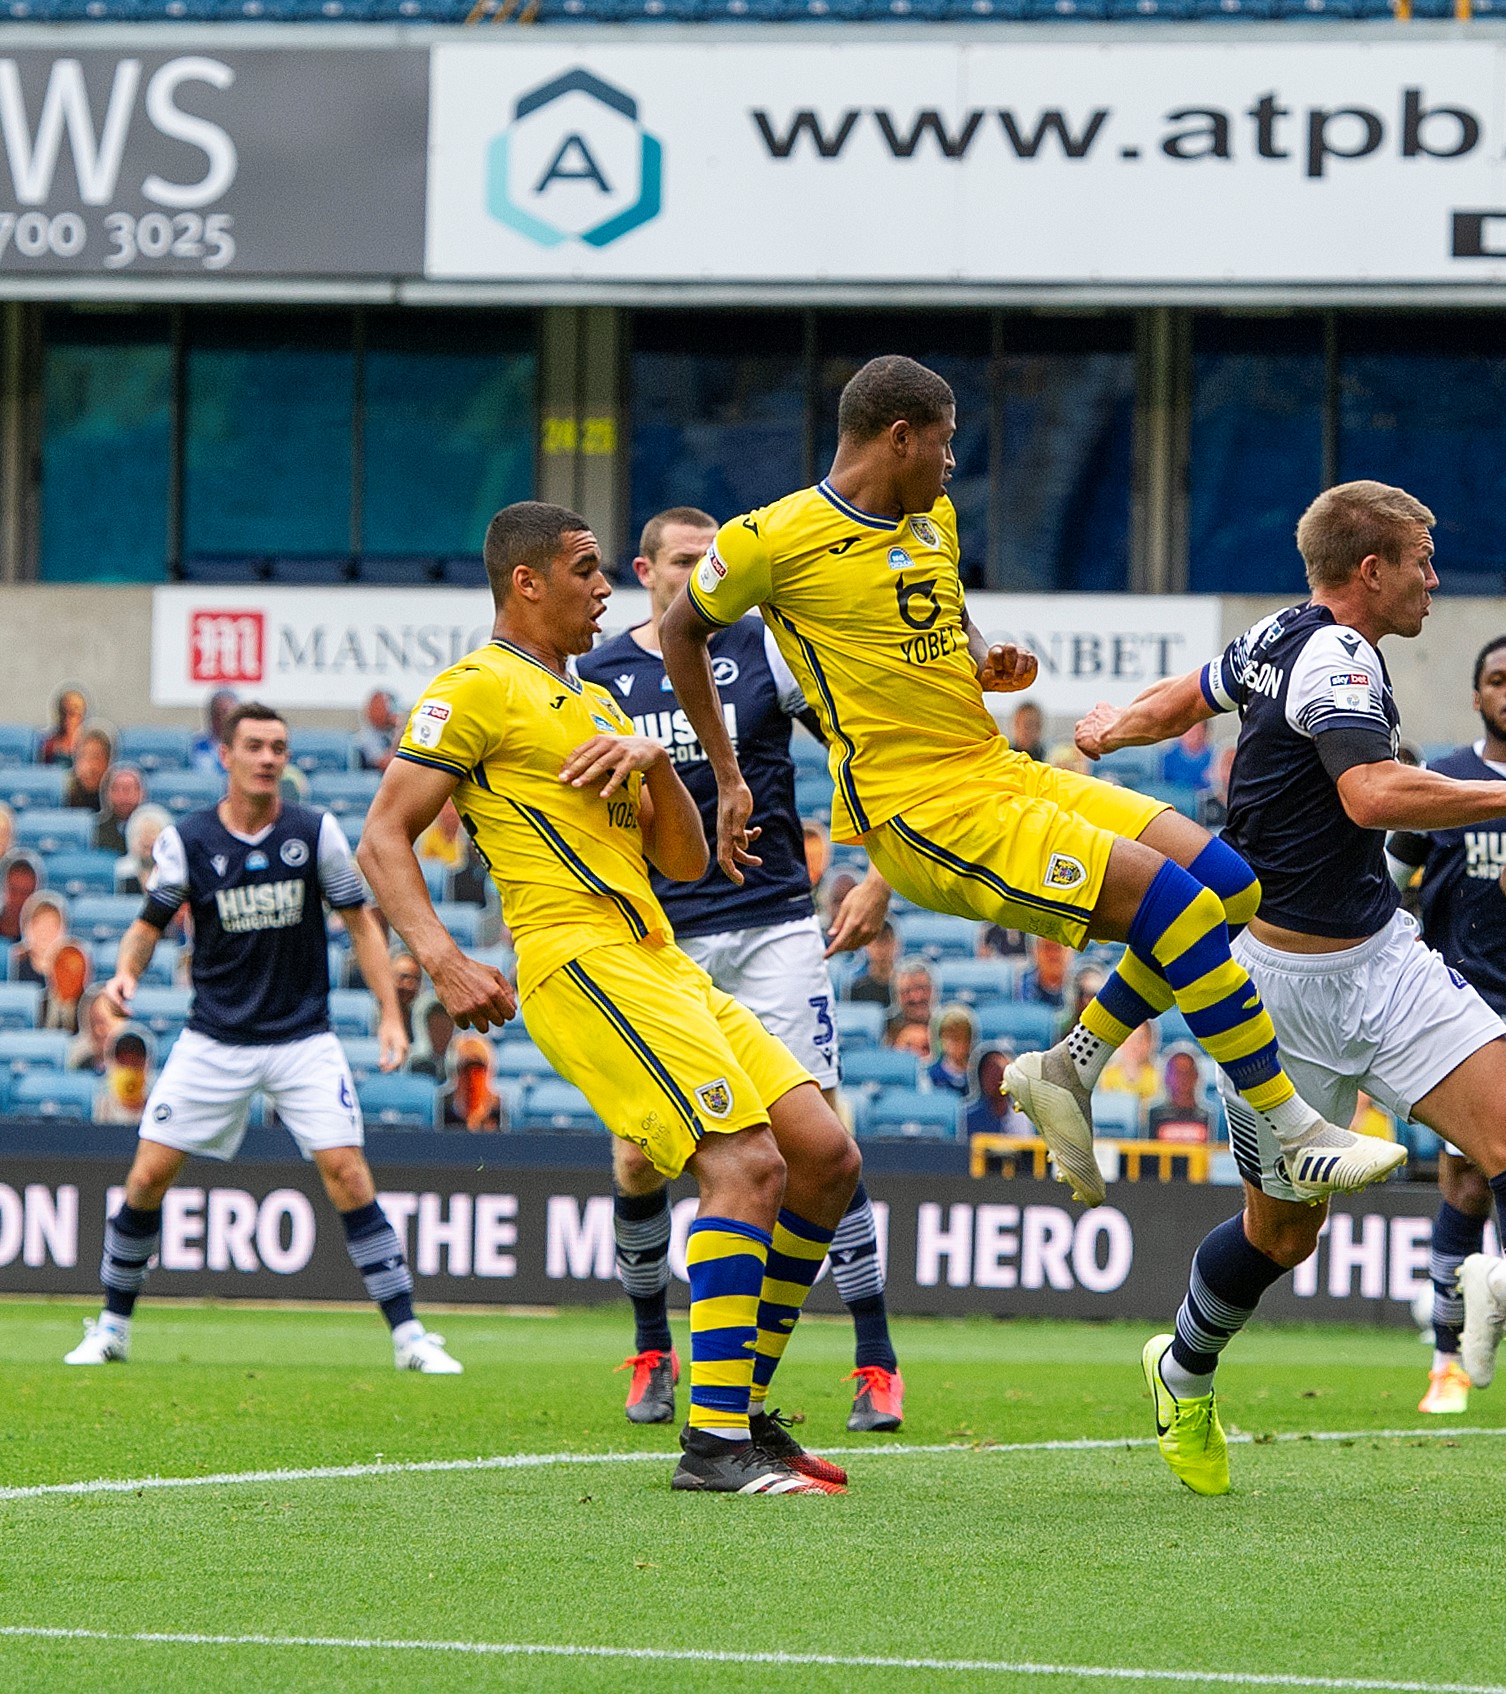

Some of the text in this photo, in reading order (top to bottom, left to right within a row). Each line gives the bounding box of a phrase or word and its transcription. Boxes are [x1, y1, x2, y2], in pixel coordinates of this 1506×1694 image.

[103, 212, 236, 270] 3025
[900, 625, 957, 663] YOBET
[985, 630, 1186, 681] NBET
[215, 879, 305, 919] HUSKI
[809, 995, 834, 1045] 3
[915, 1203, 1134, 1293] HERO
